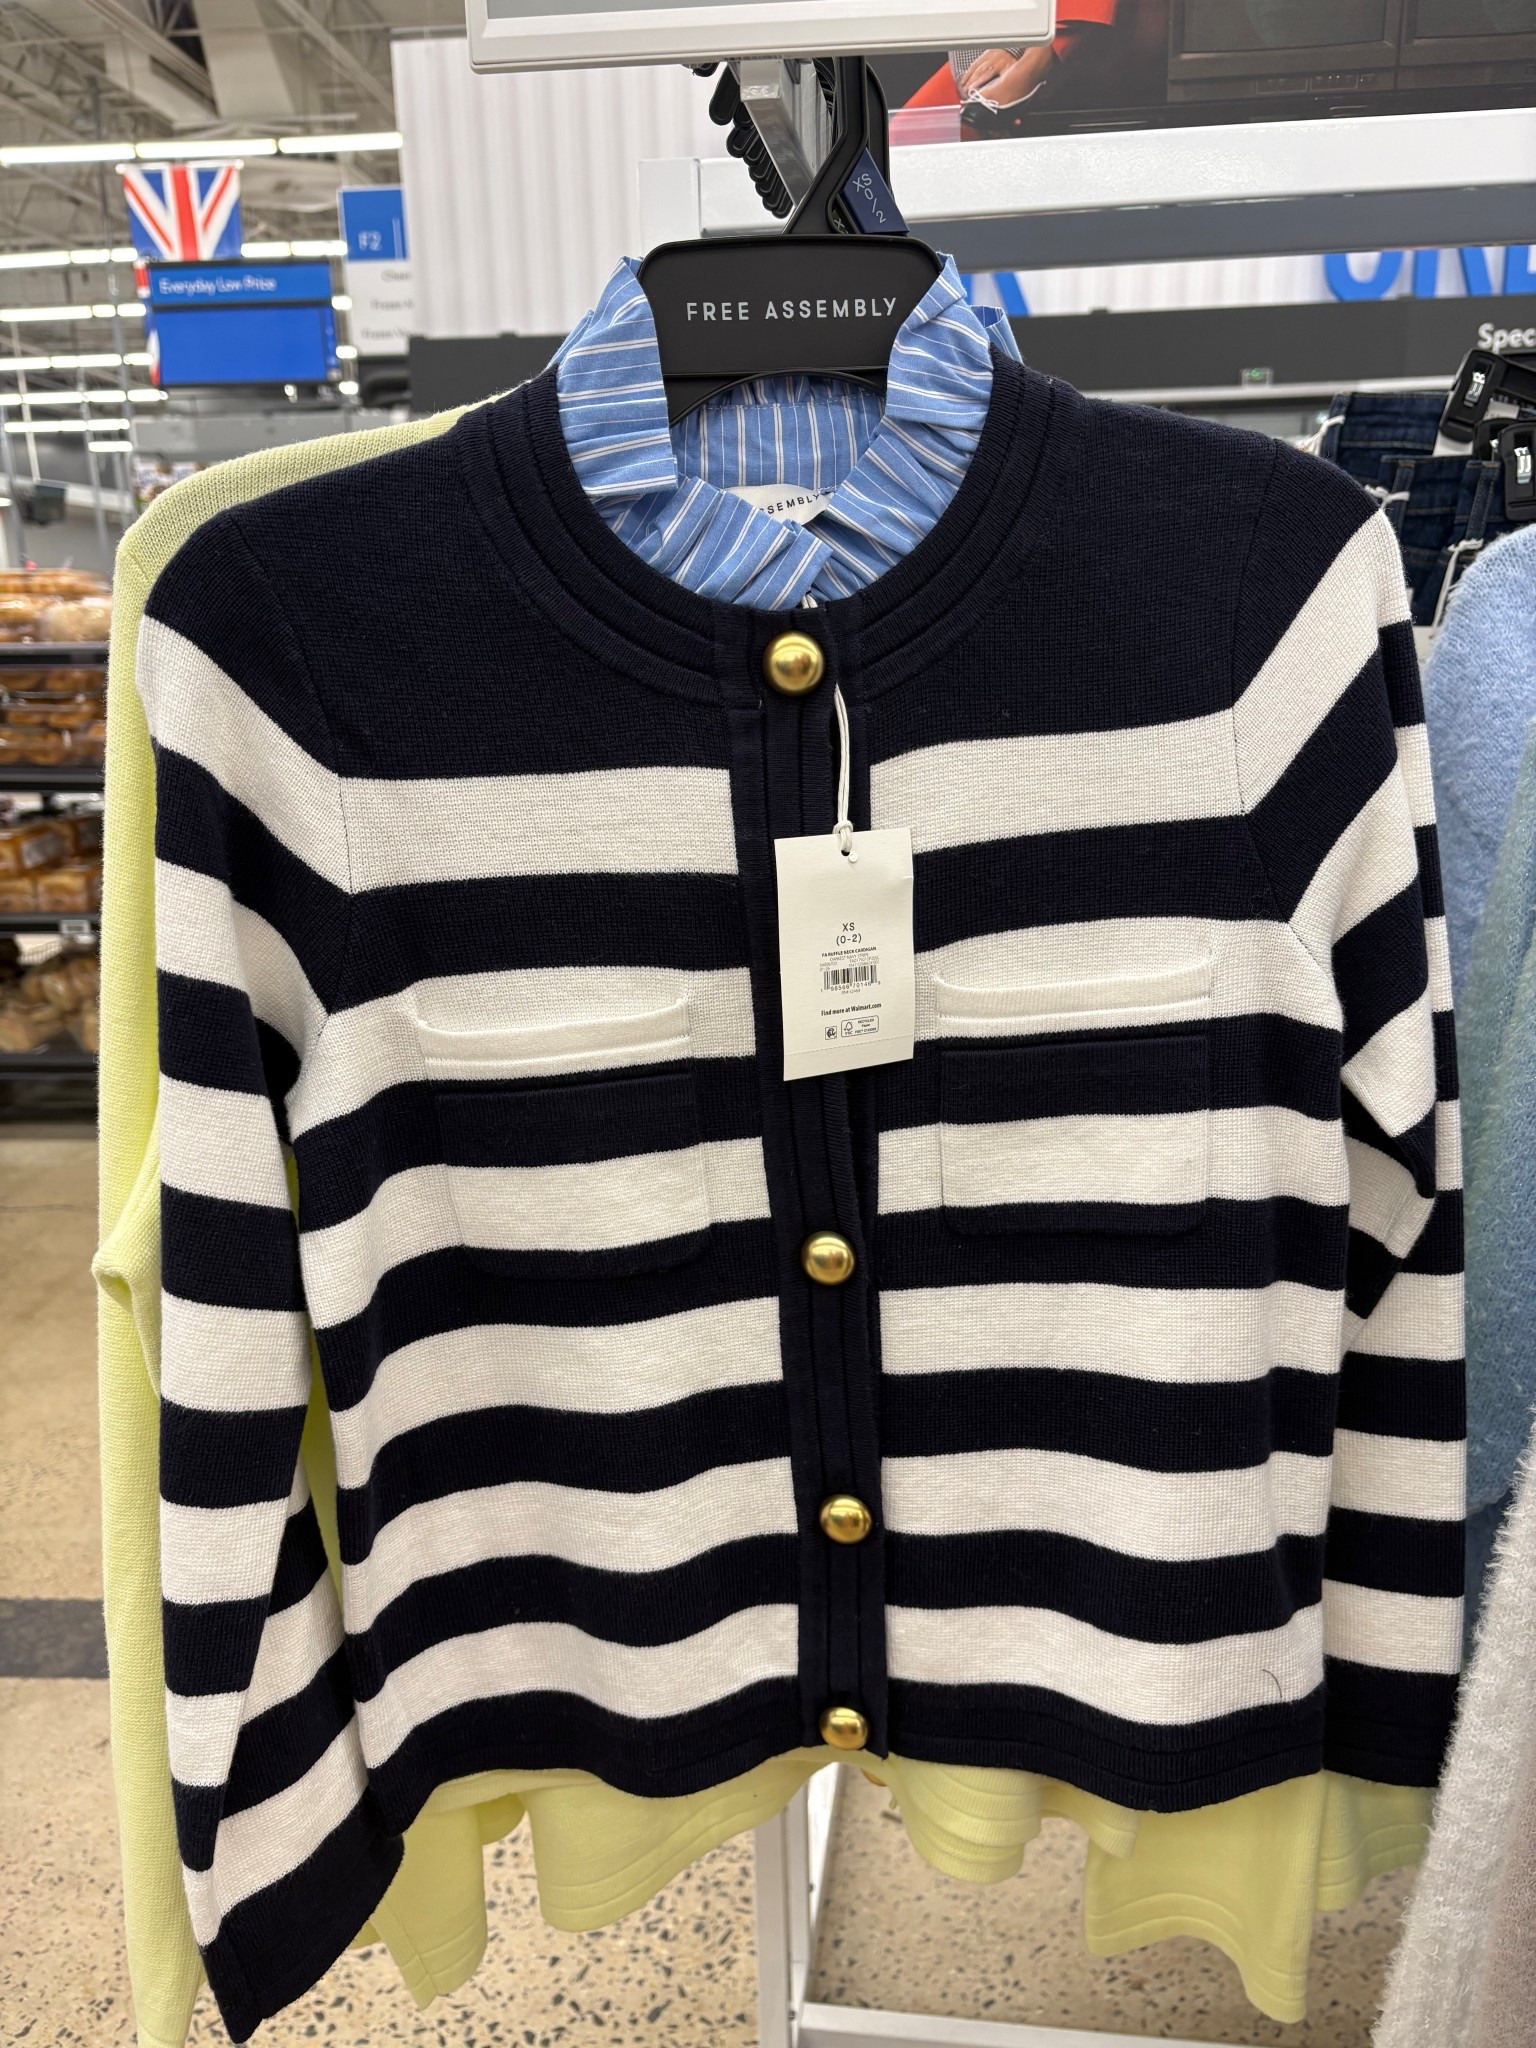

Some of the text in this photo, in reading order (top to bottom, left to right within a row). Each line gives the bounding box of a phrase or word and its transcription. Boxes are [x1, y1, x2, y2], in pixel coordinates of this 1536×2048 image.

[852, 173, 872, 192] XS
[358, 230, 382, 251] F2
[158, 274, 277, 296] Everyday Low Price
[687, 297, 897, 321] FREE ASSEMBLY
[842, 922, 855, 932] XS
[836, 933, 862, 946] (0-2)
[850, 1003, 882, 1012] Walmart.com
